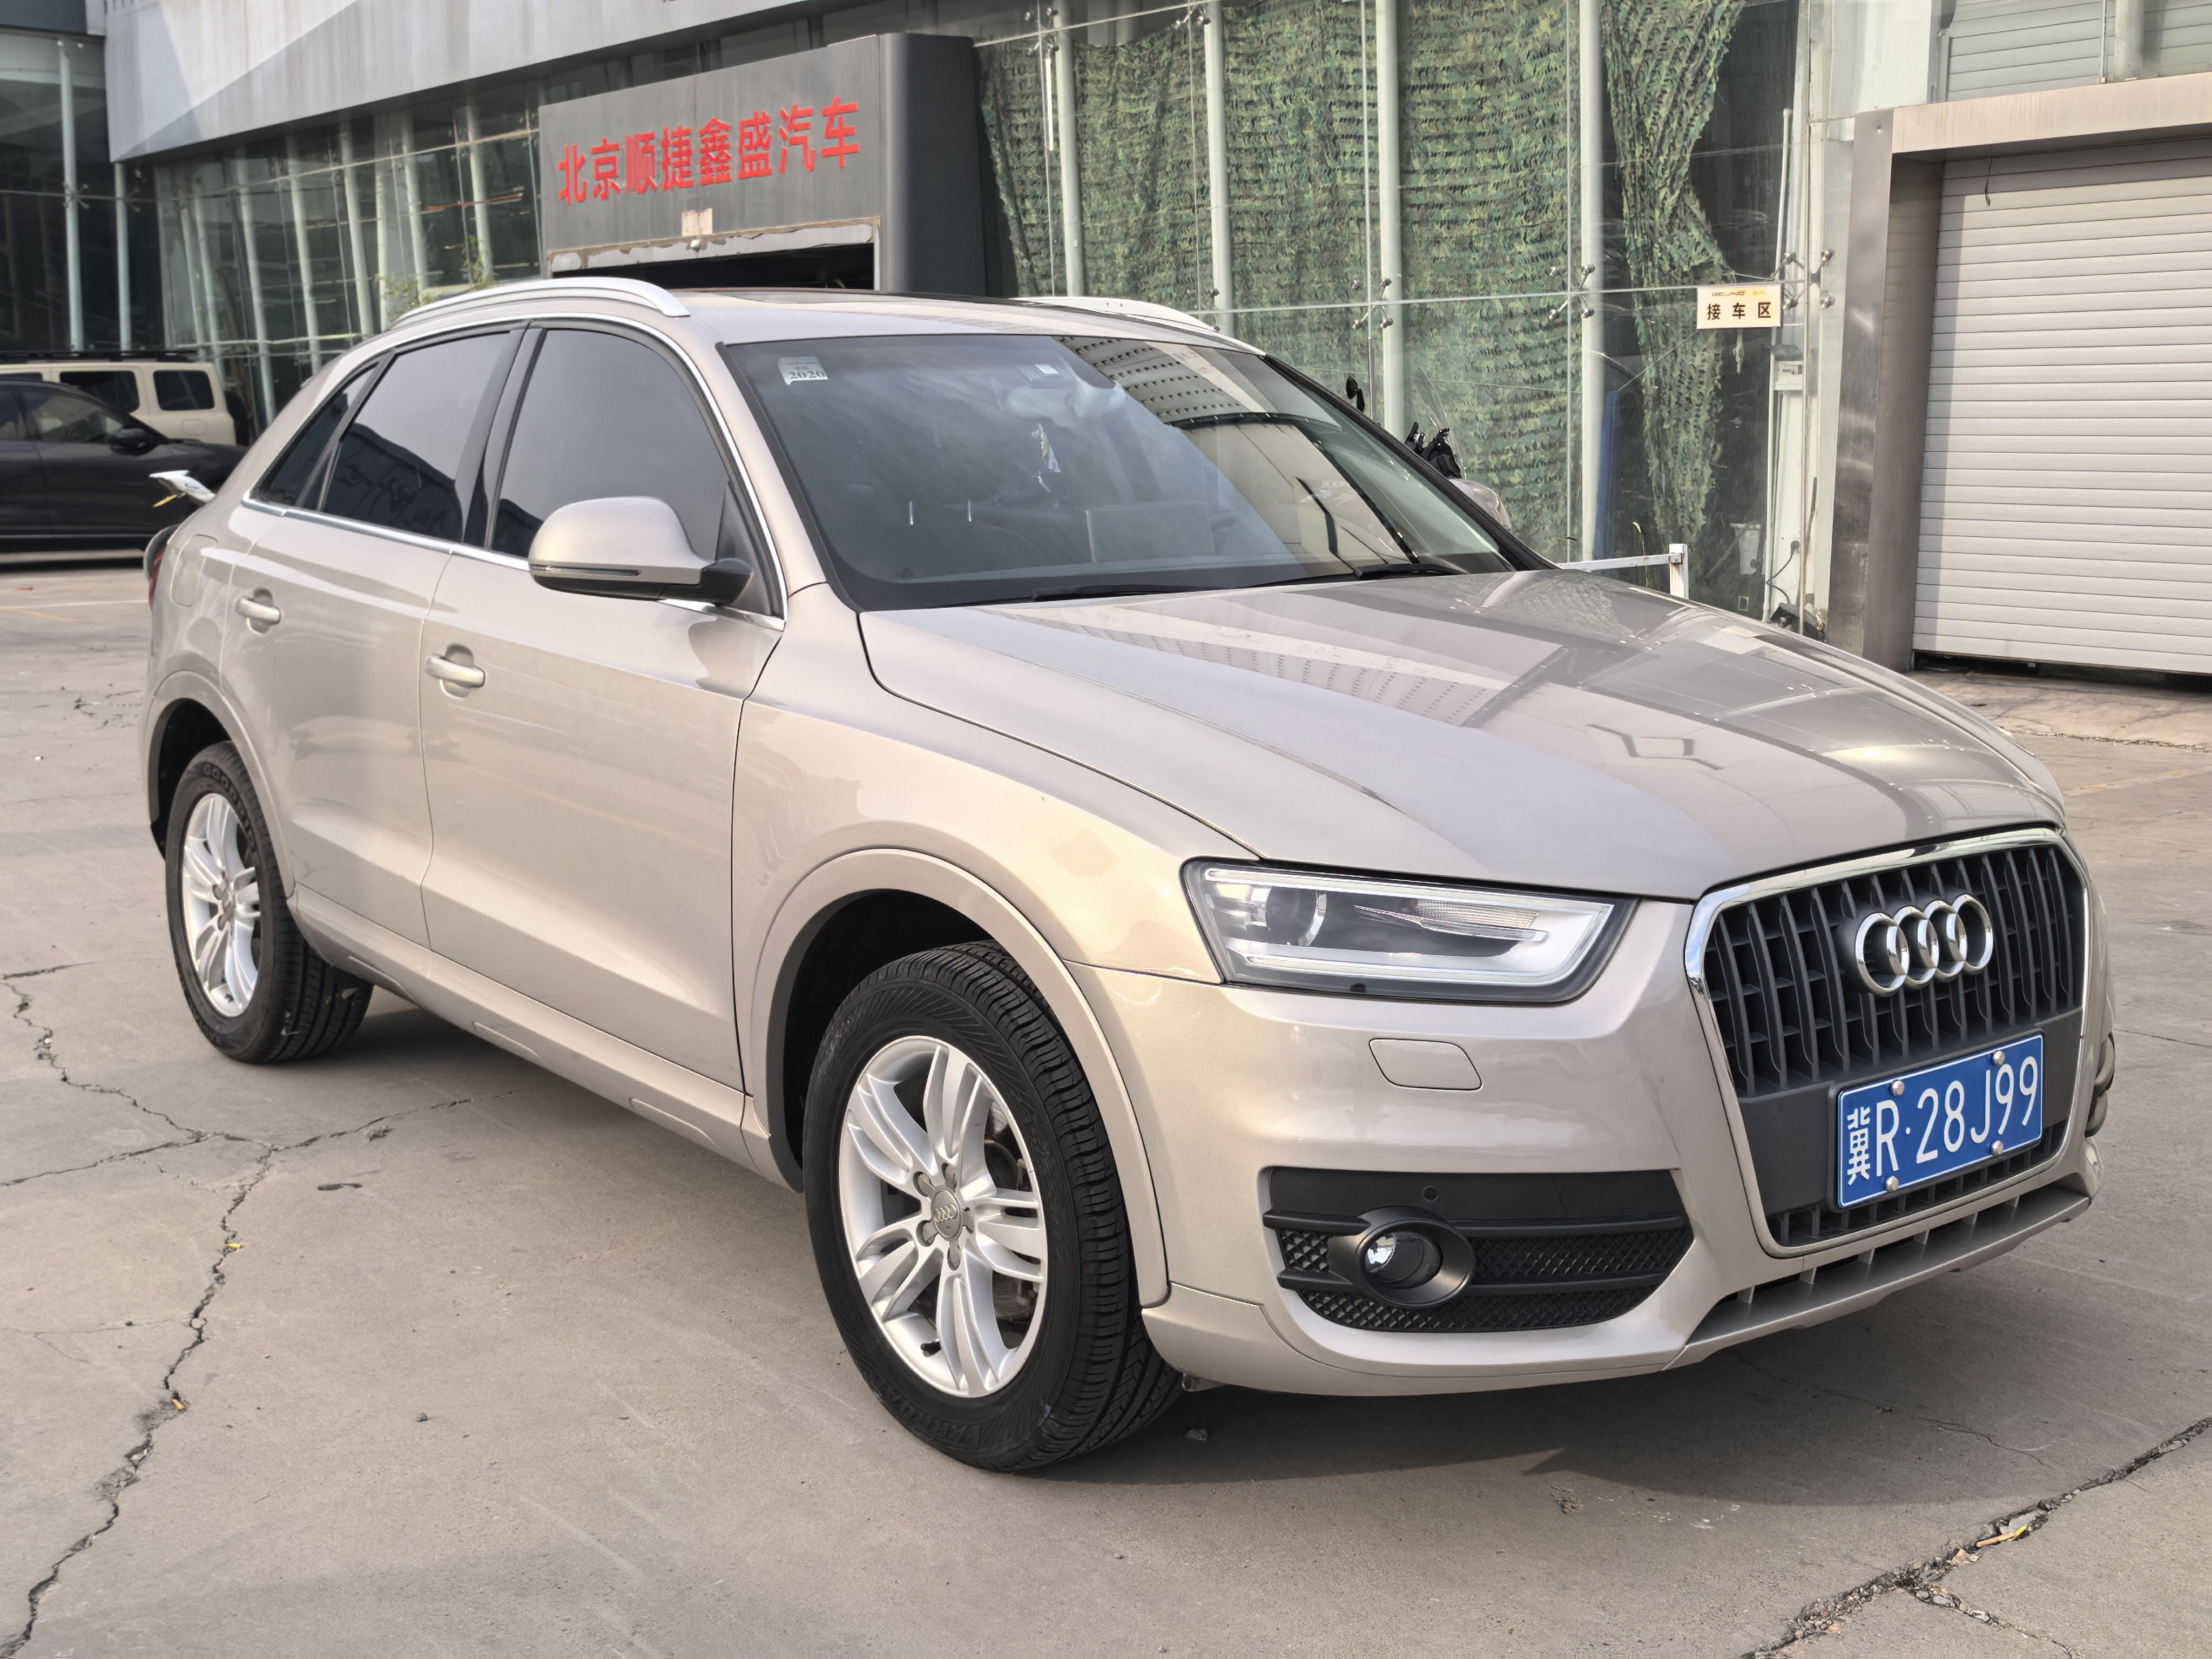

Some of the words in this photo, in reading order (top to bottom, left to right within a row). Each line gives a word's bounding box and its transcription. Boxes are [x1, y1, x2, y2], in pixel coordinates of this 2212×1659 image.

[558, 96, 860, 205] 北京顺捷鑫盛汽车
[1707, 302, 1771, 320] 接车区
[788, 370, 826, 379] 2020
[1846, 1056, 2038, 1185] 冀R·28J99
